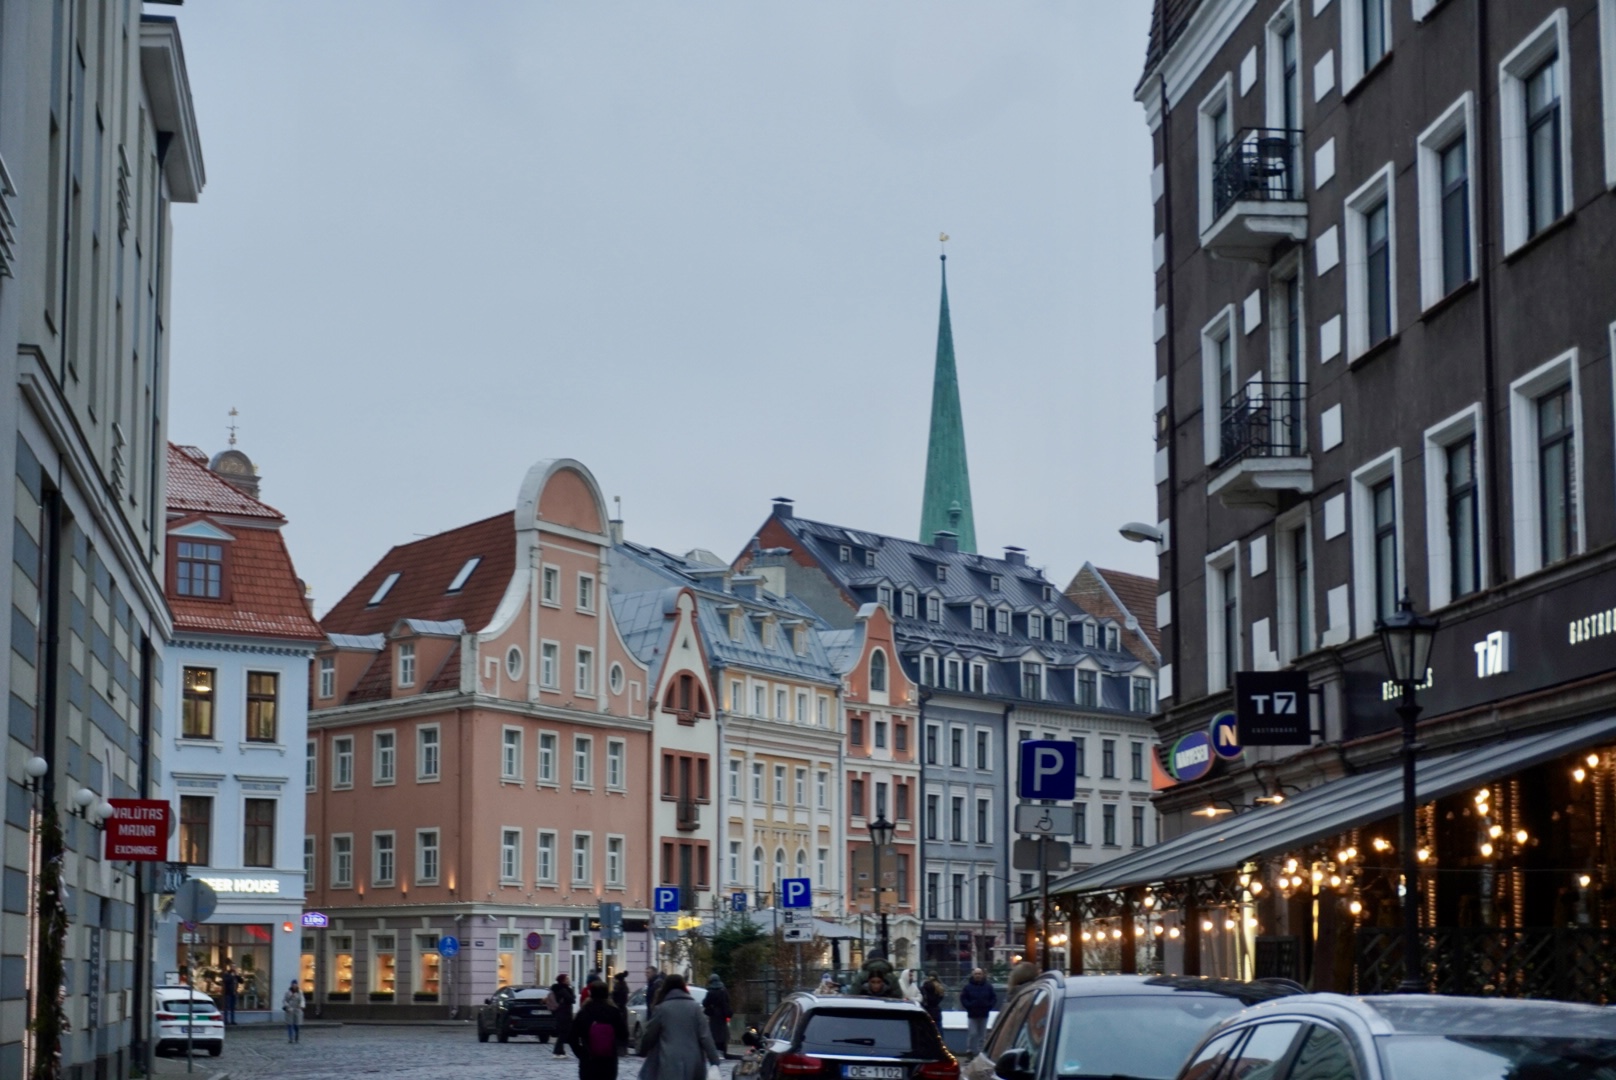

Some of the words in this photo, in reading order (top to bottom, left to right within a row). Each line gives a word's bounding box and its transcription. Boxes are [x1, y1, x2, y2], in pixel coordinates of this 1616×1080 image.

[1474, 630, 1506, 678] T7
[1219, 725, 1238, 746] N
[1033, 747, 1064, 792] P
[113, 805, 164, 821] VALŪTAS
[114, 845, 159, 856] EXCHANGE
[201, 878, 233, 892] EER
[234, 878, 280, 893] HOUSE
[788, 882, 805, 905] P
[660, 890, 674, 910] P
[90, 934, 99, 1021] EXCHANGE
[850, 1066, 901, 1078] OE-1102
